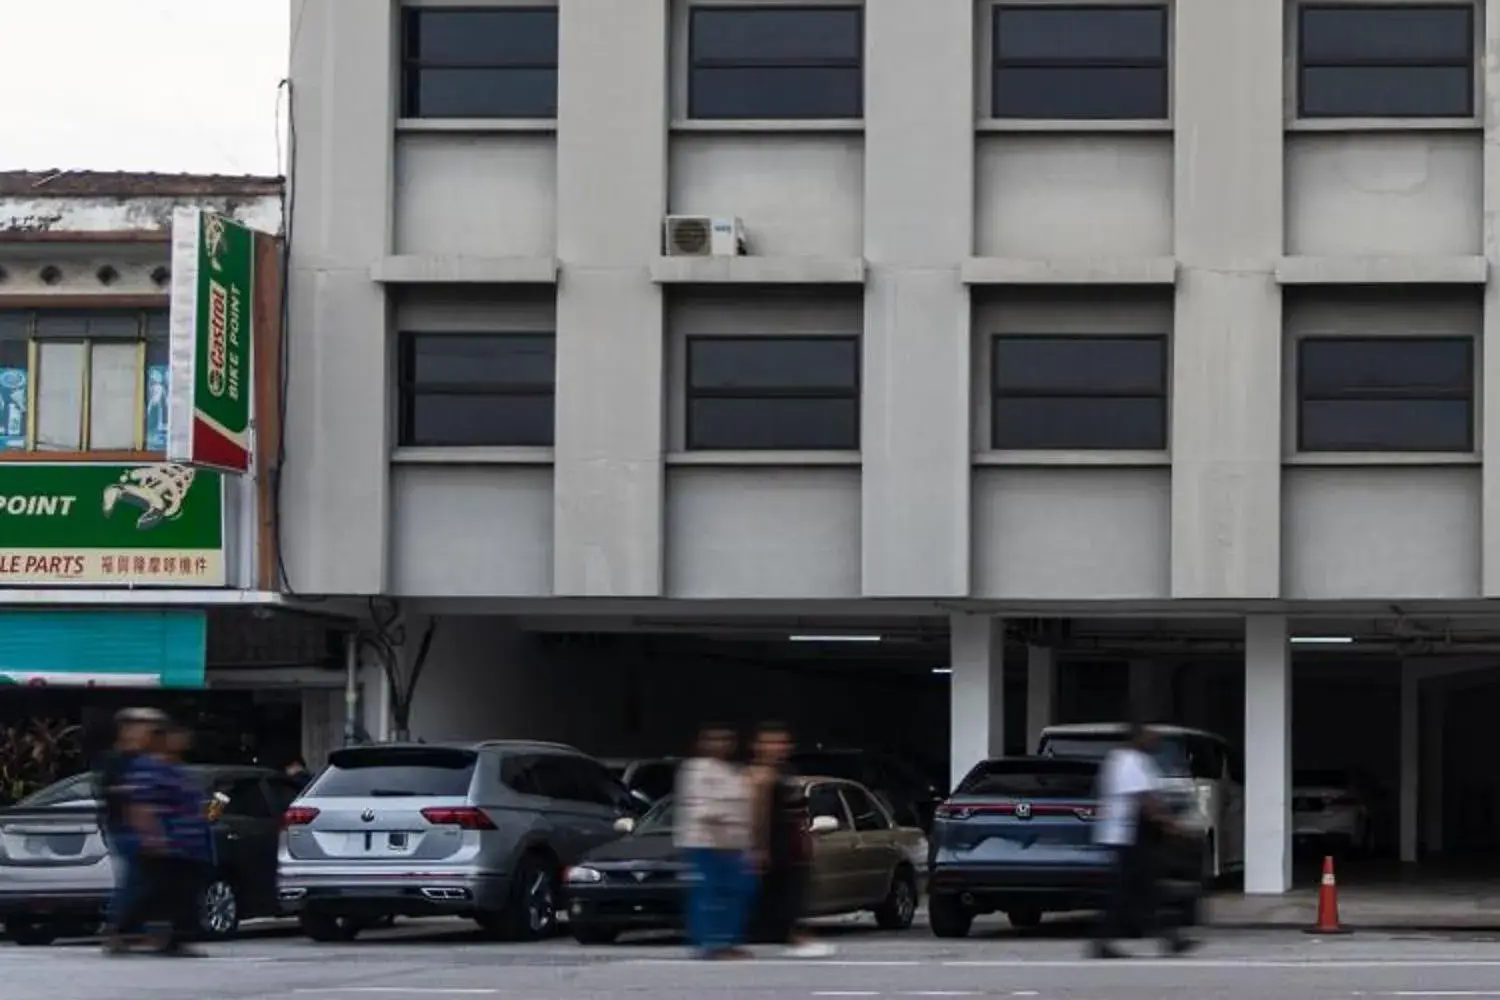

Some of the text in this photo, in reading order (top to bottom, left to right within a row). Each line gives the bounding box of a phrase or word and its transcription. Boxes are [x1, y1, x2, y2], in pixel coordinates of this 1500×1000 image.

[211, 285, 225, 369] Castrol
[228, 281, 241, 401] BIKE POINT
[25, 555, 84, 575] PARTS
